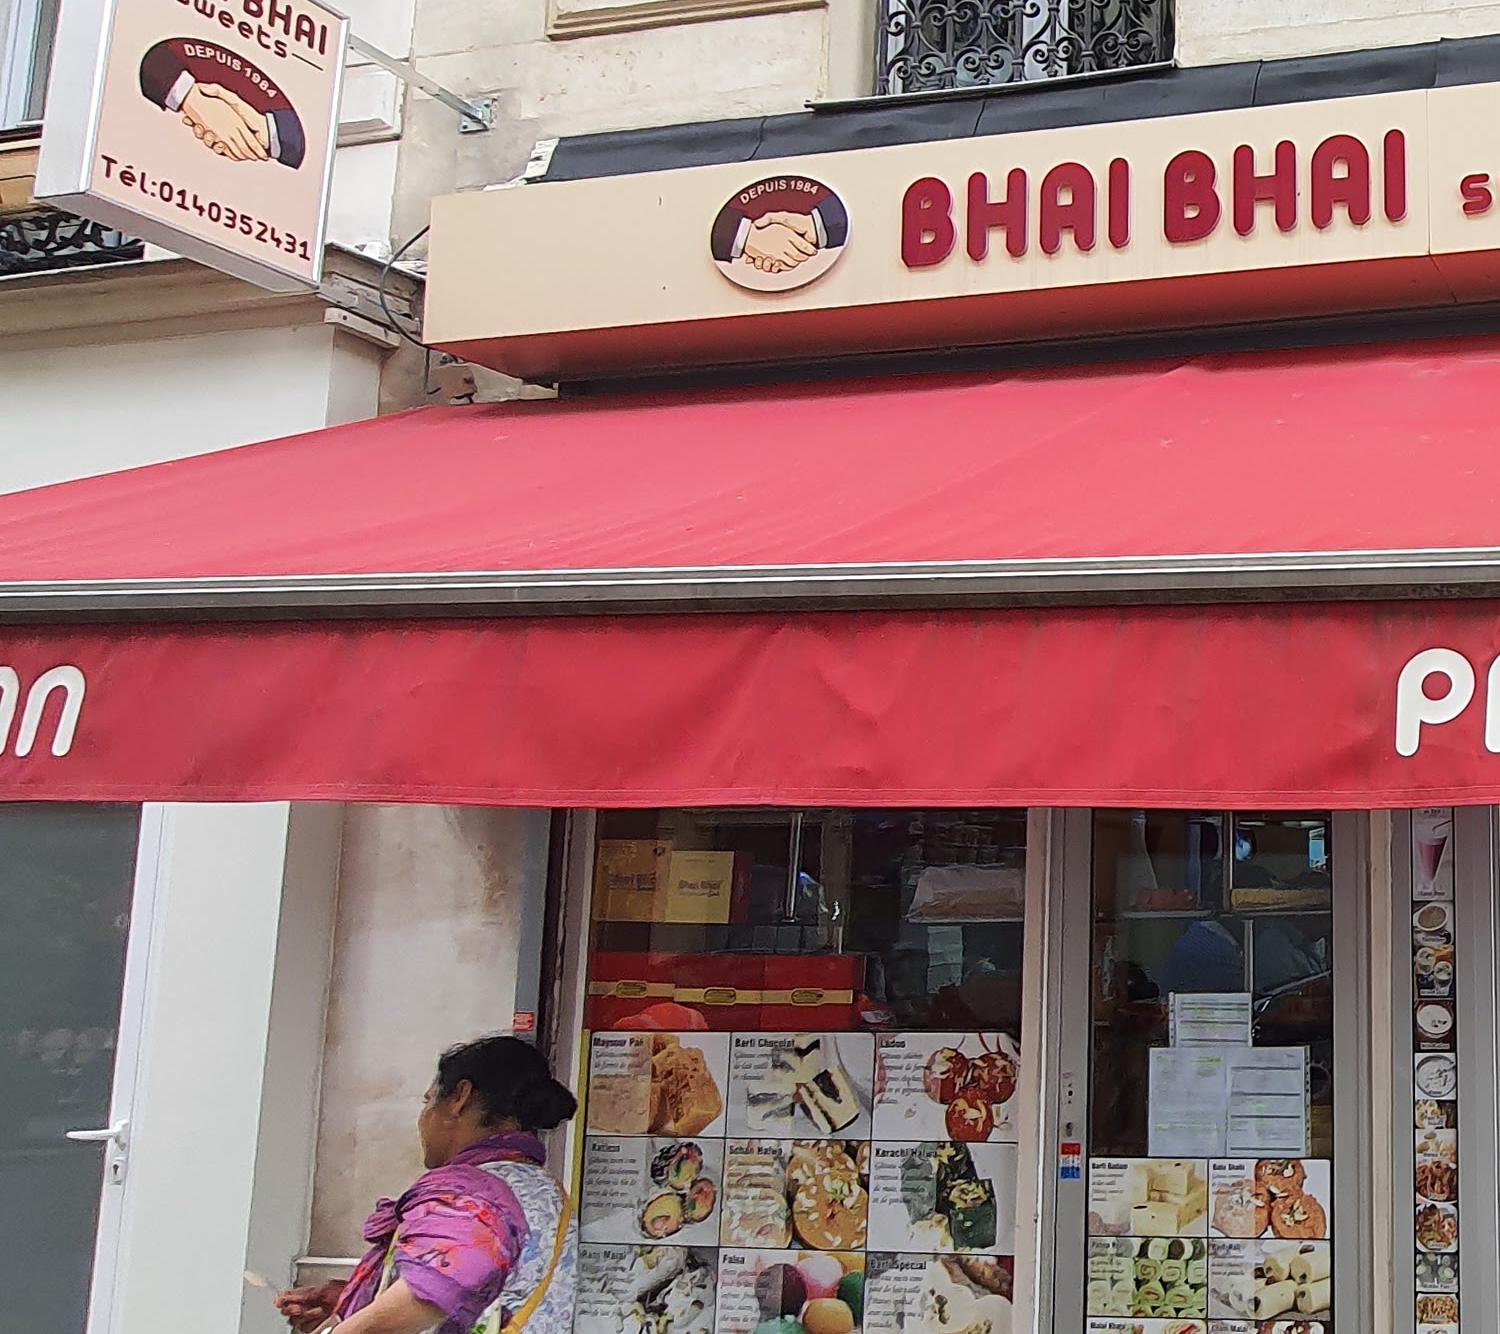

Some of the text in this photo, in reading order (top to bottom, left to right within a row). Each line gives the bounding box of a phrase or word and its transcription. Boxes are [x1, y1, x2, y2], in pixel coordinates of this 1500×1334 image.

[183, 43, 279, 99] DEPUIS 1984
[101, 153, 311, 263] Tél:0140352431
[740, 179, 819, 204] DEPUIS 1984
[901, 128, 1407, 270] BHAI BHAI
